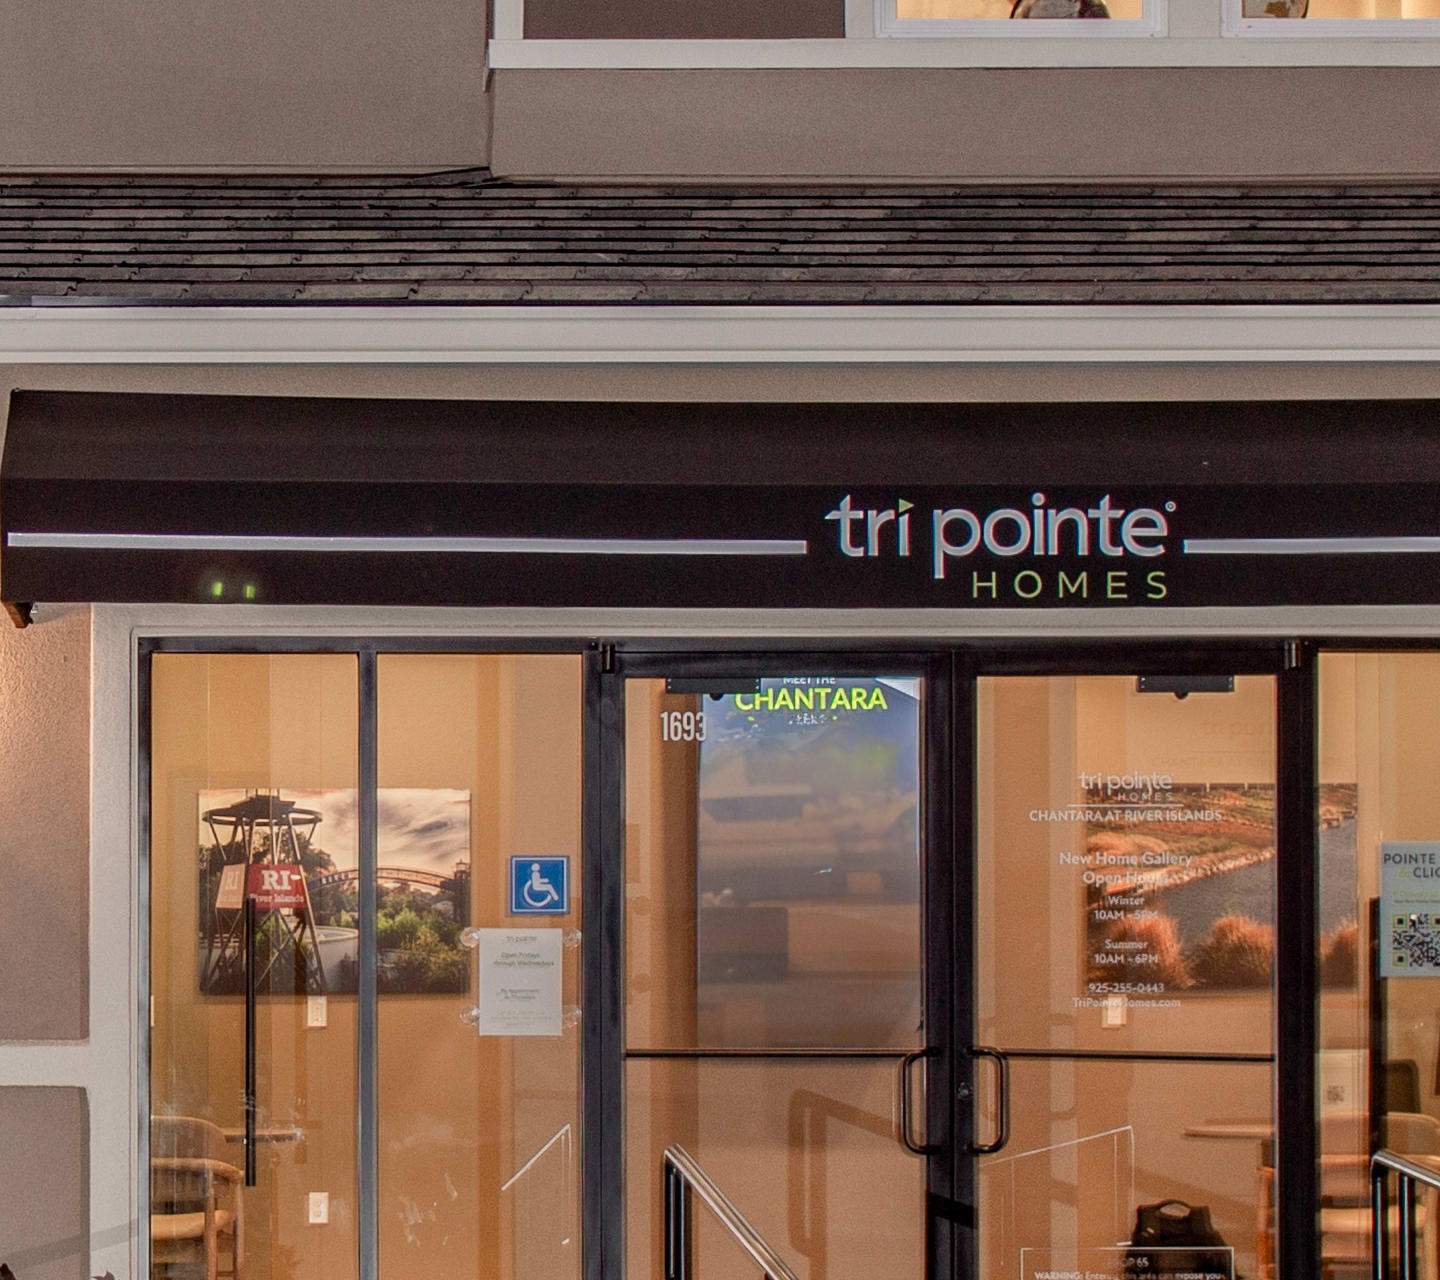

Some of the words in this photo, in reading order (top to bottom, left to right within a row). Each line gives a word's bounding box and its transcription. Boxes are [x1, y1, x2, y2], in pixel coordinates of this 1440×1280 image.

[825, 494, 914, 558] tri
[972, 570, 1168, 600] HOMES
[735, 687, 888, 711] CHANTARA
[1079, 771, 1102, 790] tri
[1106, 771, 1173, 797] pointe
[1028, 809, 1101, 821] CHANTARA
[1102, 810, 1121, 821] AT
[1124, 810, 1164, 821] RIVER
[1166, 809, 1222, 821] ISLANDS
[1059, 852, 1092, 865] New
[1095, 852, 1138, 865] Home
[1141, 851, 1193, 867] Gallery
[1383, 853, 1436, 865] POINTE
[1082, 871, 1121, 887] Open
[1107, 895, 1146, 906] Winter
[1094, 909, 1124, 920] 10AM
[1104, 939, 1148, 949] Summer
[1094, 953, 1124, 964] 10AM
[1135, 953, 1159, 964] 6PM
[1136, 1257, 1149, 1267] 65
